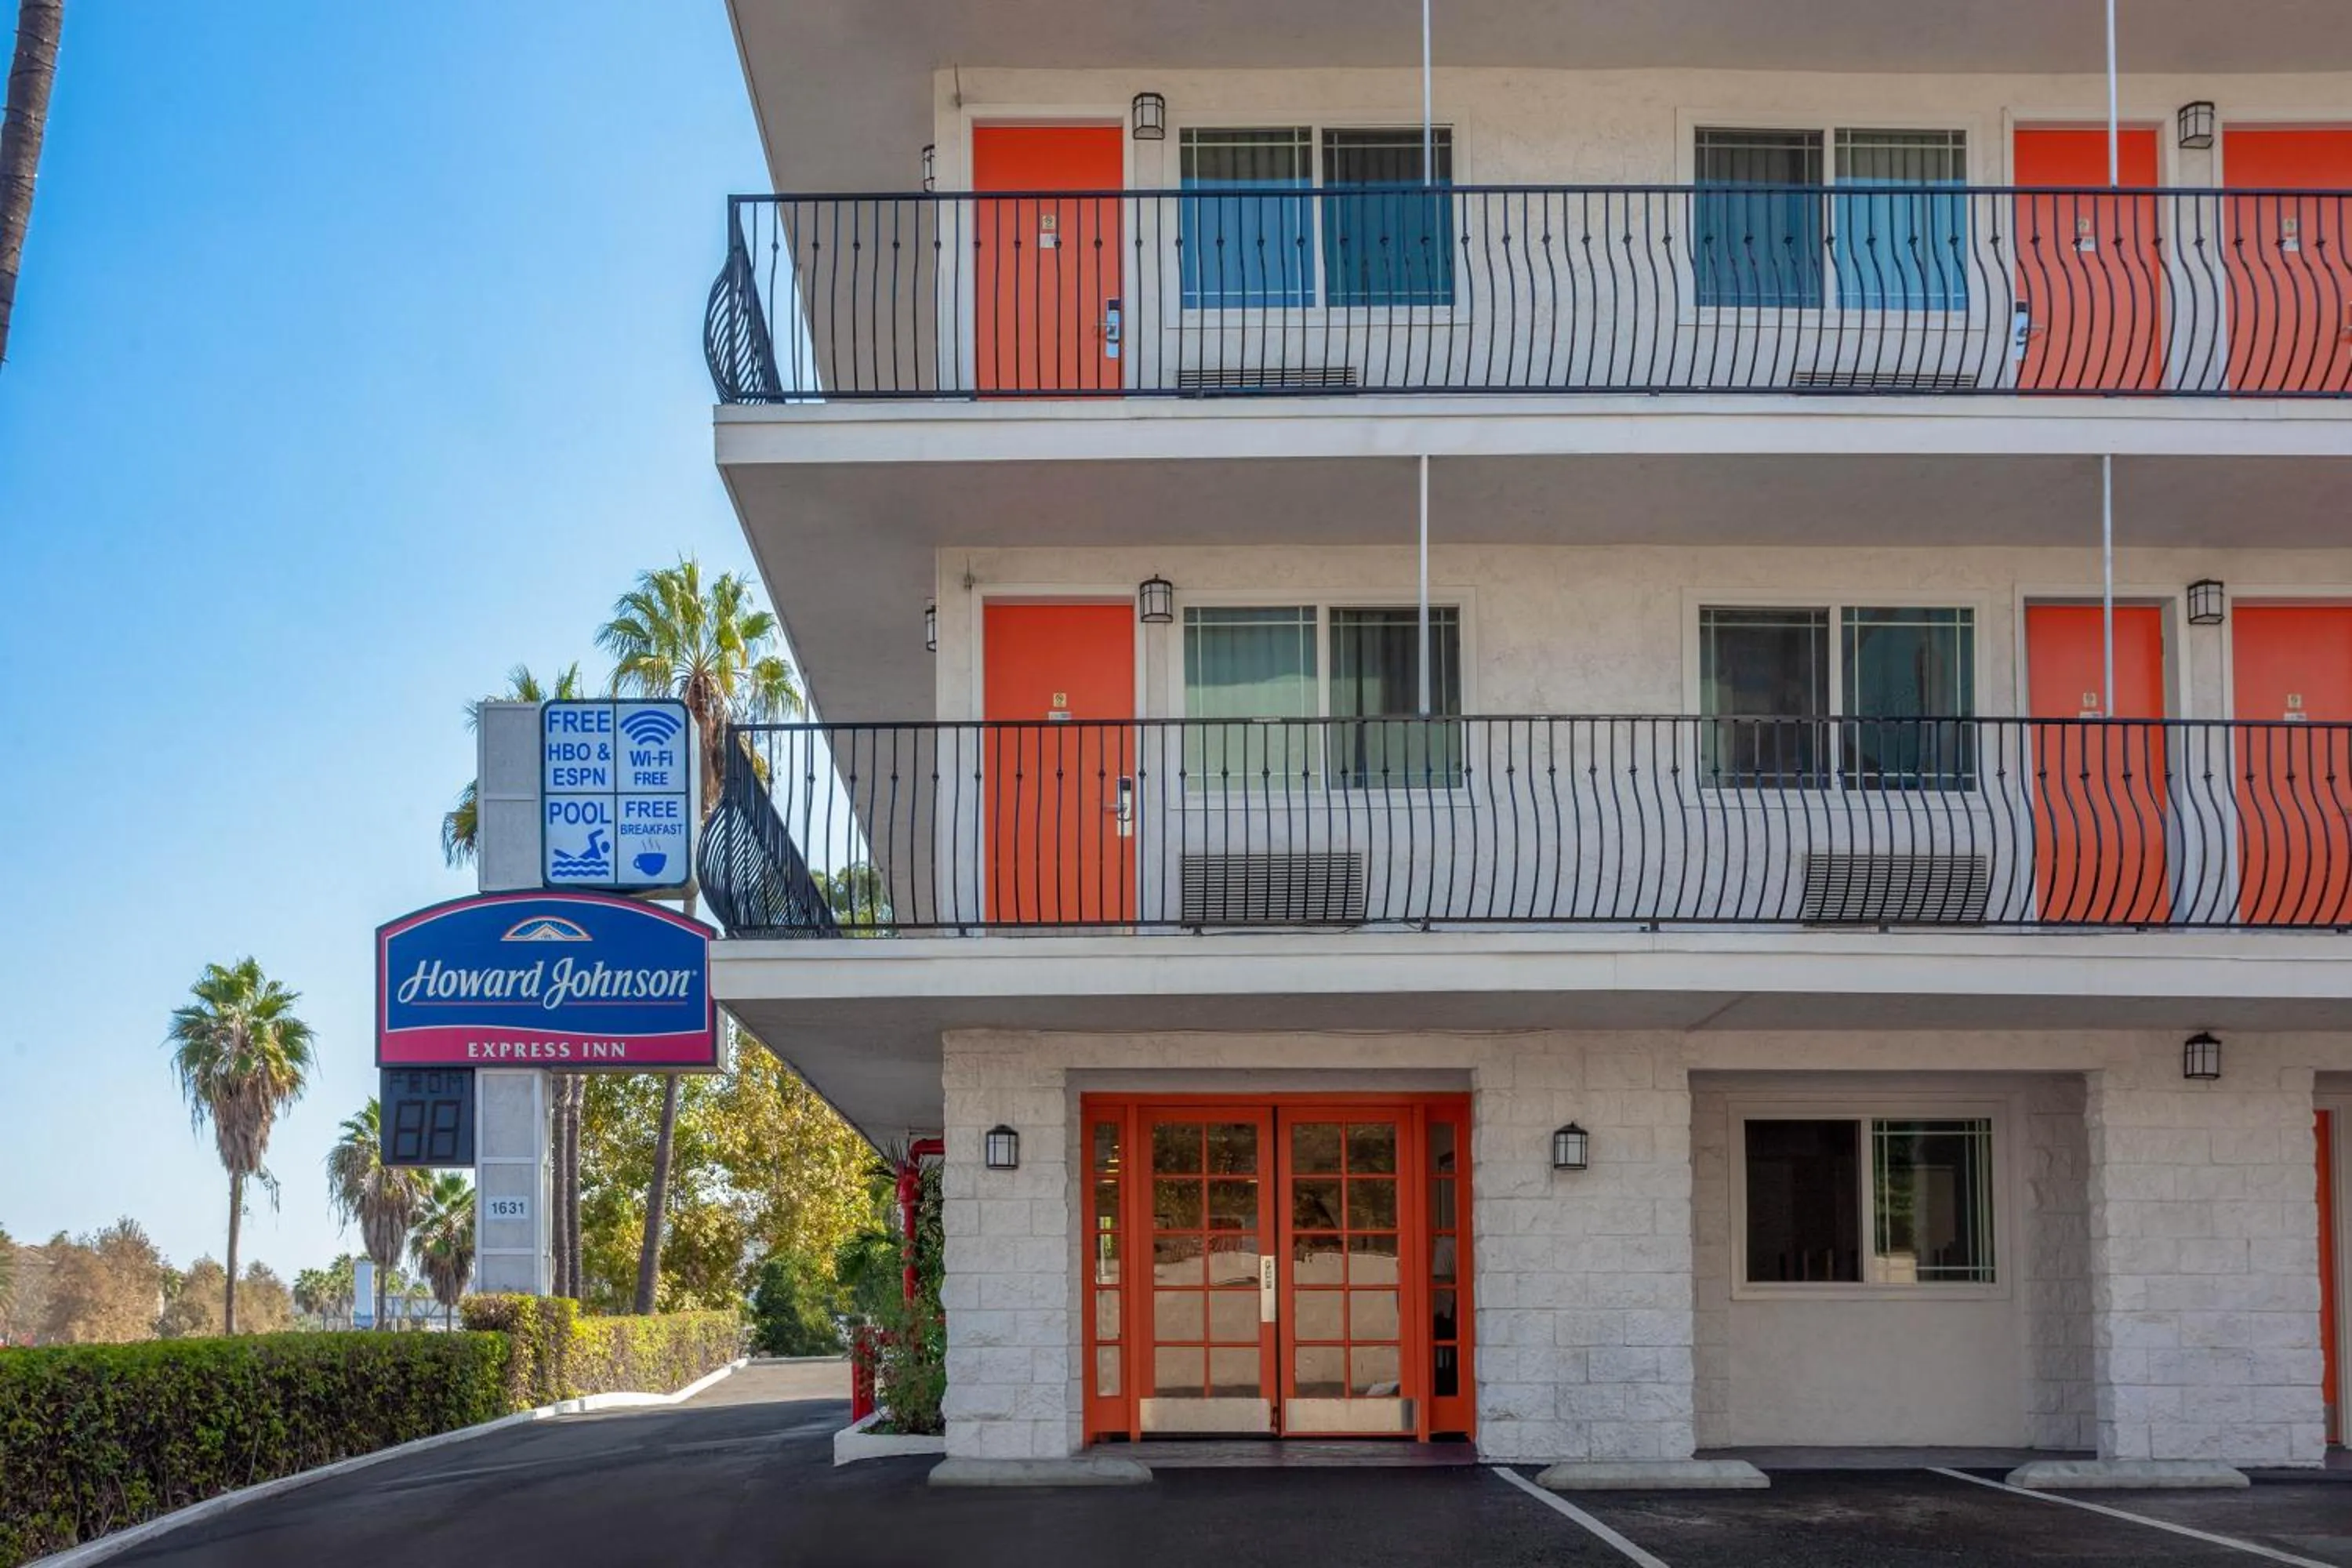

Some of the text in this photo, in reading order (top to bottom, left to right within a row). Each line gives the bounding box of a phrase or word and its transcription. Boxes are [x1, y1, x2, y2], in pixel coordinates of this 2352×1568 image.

[548, 710, 611, 733] FREE
[548, 742, 611, 761] HBO &
[630, 750, 673, 767] Wi-Fi
[553, 768, 605, 786] ESPN
[633, 771, 669, 786] FREE
[549, 801, 612, 825] POOL
[626, 800, 678, 818] FREE
[620, 824, 683, 836] BREAKFAST
[397, 957, 690, 1010] Howard Johnson
[468, 1042, 626, 1058] EXPRESS INN
[490, 1202, 525, 1214] 1631
